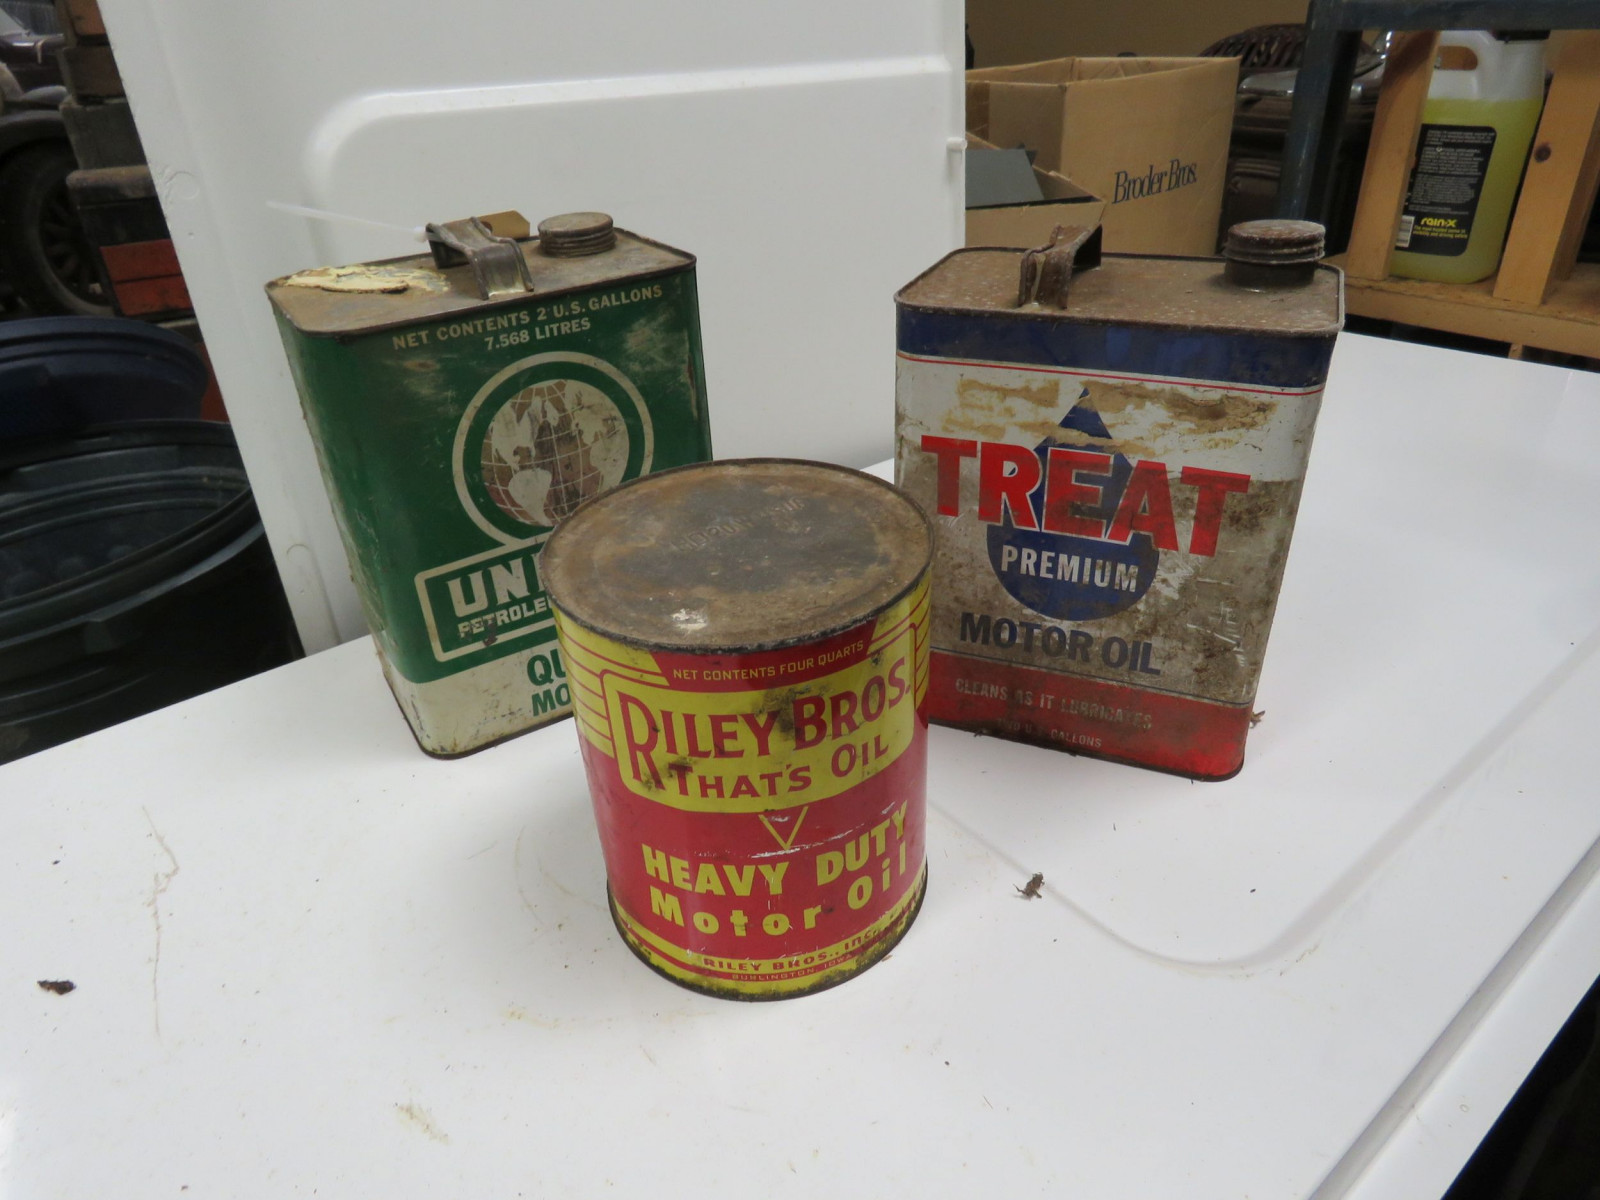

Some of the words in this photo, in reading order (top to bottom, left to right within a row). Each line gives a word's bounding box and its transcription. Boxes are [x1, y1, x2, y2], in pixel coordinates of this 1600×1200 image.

[1112, 164, 1168, 205] Broder
[392, 330, 431, 351] NET
[436, 310, 531, 342] CONTENTS
[536, 307, 548, 322] 2
[553, 299, 586, 318] U.S.
[588, 284, 663, 312] GALLONS
[484, 329, 530, 351] 7.568
[534, 317, 592, 341] LITRES
[920, 434, 1251, 557] TREAT
[1001, 544, 1139, 593] PREMIUM
[457, 596, 556, 639] PETROLE
[673, 668, 698, 681] NET
[703, 666, 776, 681] CONTENTS
[779, 659, 814, 675] FOUR
[817, 640, 864, 667] QUARTS
[959, 612, 1095, 663] MOTOR
[1101, 636, 1161, 676] OIL
[617, 690, 783, 791] RILEY
[792, 656, 911, 751] BROS.
[955, 678, 1008, 700] CLEANS
[1040, 694, 1055, 709] IT
[1060, 697, 1152, 729] LUBRICAES
[668, 763, 812, 799] THAT'S
[831, 734, 891, 777] OIL
[642, 843, 789, 896] HEAVY
[816, 799, 908, 887] DUTY
[650, 885, 822, 937] Motor
[847, 841, 907, 910] Oil
[703, 958, 761, 971] RILEY
[824, 953, 853, 969] IOWA
